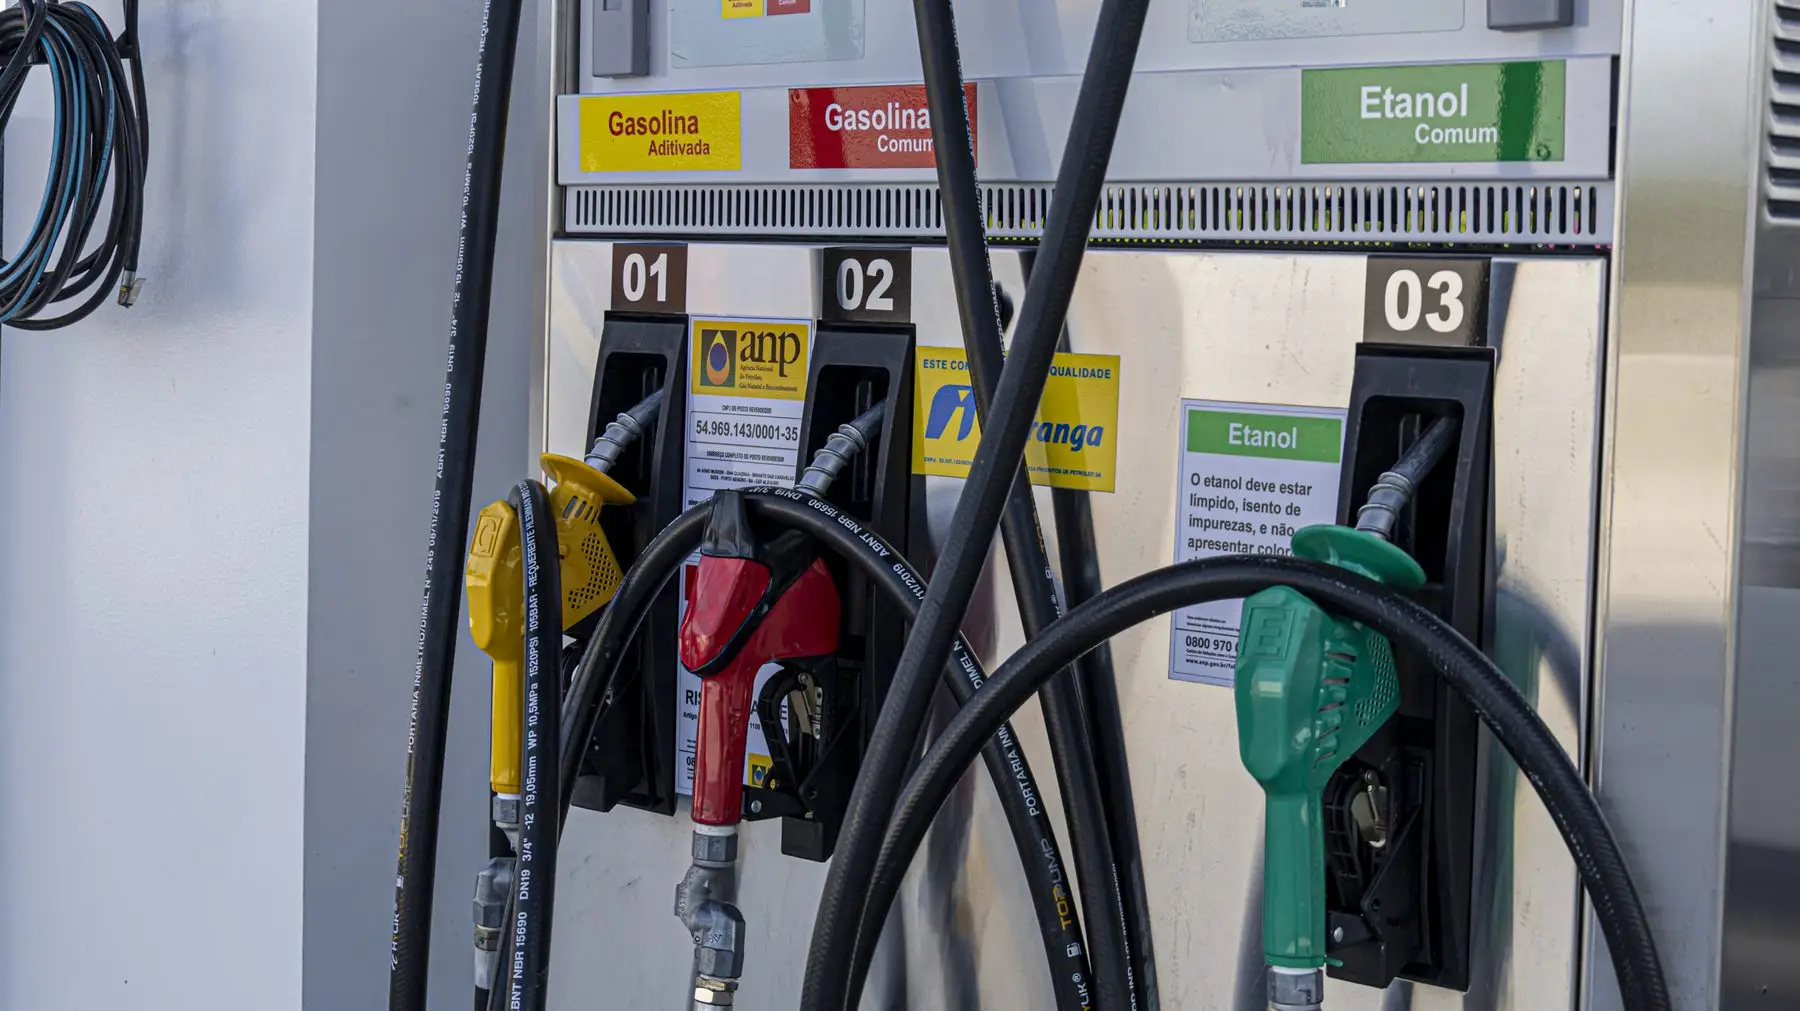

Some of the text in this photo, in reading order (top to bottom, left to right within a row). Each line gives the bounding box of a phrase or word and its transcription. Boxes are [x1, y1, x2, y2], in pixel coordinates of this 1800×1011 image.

[1361, 83, 1468, 119] Etanol
[608, 110, 699, 136] Gasolina
[825, 103, 930, 132] Gasolina
[878, 134, 934, 153] Comum
[1415, 124, 1498, 144] Comum
[648, 139, 710, 156] Aditivada
[622, 253, 668, 302] 01
[836, 258, 894, 311] 02
[1384, 269, 1465, 332] 03
[740, 330, 800, 378] anp
[923, 358, 948, 370] ESTE
[1050, 366, 1112, 379] QUALIDADE
[696, 420, 798, 442] 54.969.143/0001-35
[1228, 422, 1297, 449] Etanol
[774, 488, 802, 501] DN19
[1190, 472, 1312, 496] O etanol deve estar
[808, 498, 838, 520] 15690
[1190, 493, 1300, 516] límpido, isento de
[837, 514, 862, 534] NBR
[1188, 515, 1294, 538] impurezas, e não
[526, 529, 540, 586] REQUERENTE
[859, 533, 891, 558] ABNT
[1188, 538, 1254, 554] apresentar
[528, 594, 539, 631] 105BAR
[1186, 636, 1210, 649] 0800
[1213, 640, 1232, 652] 970
[1256, 608, 1287, 655] E
[529, 637, 539, 676] 1520PSI
[961, 652, 984, 690] DIMEL
[529, 683, 540, 726] 10,5MPa
[408, 690, 420, 754] PORTARIA
[528, 730, 538, 749] WP
[525, 756, 537, 806] 19,05mm
[1007, 749, 1040, 817] PORTARIA
[525, 814, 534, 830] -12
[519, 870, 531, 900] DN19
[516, 912, 528, 946] 15690
[514, 952, 524, 978] NBR
